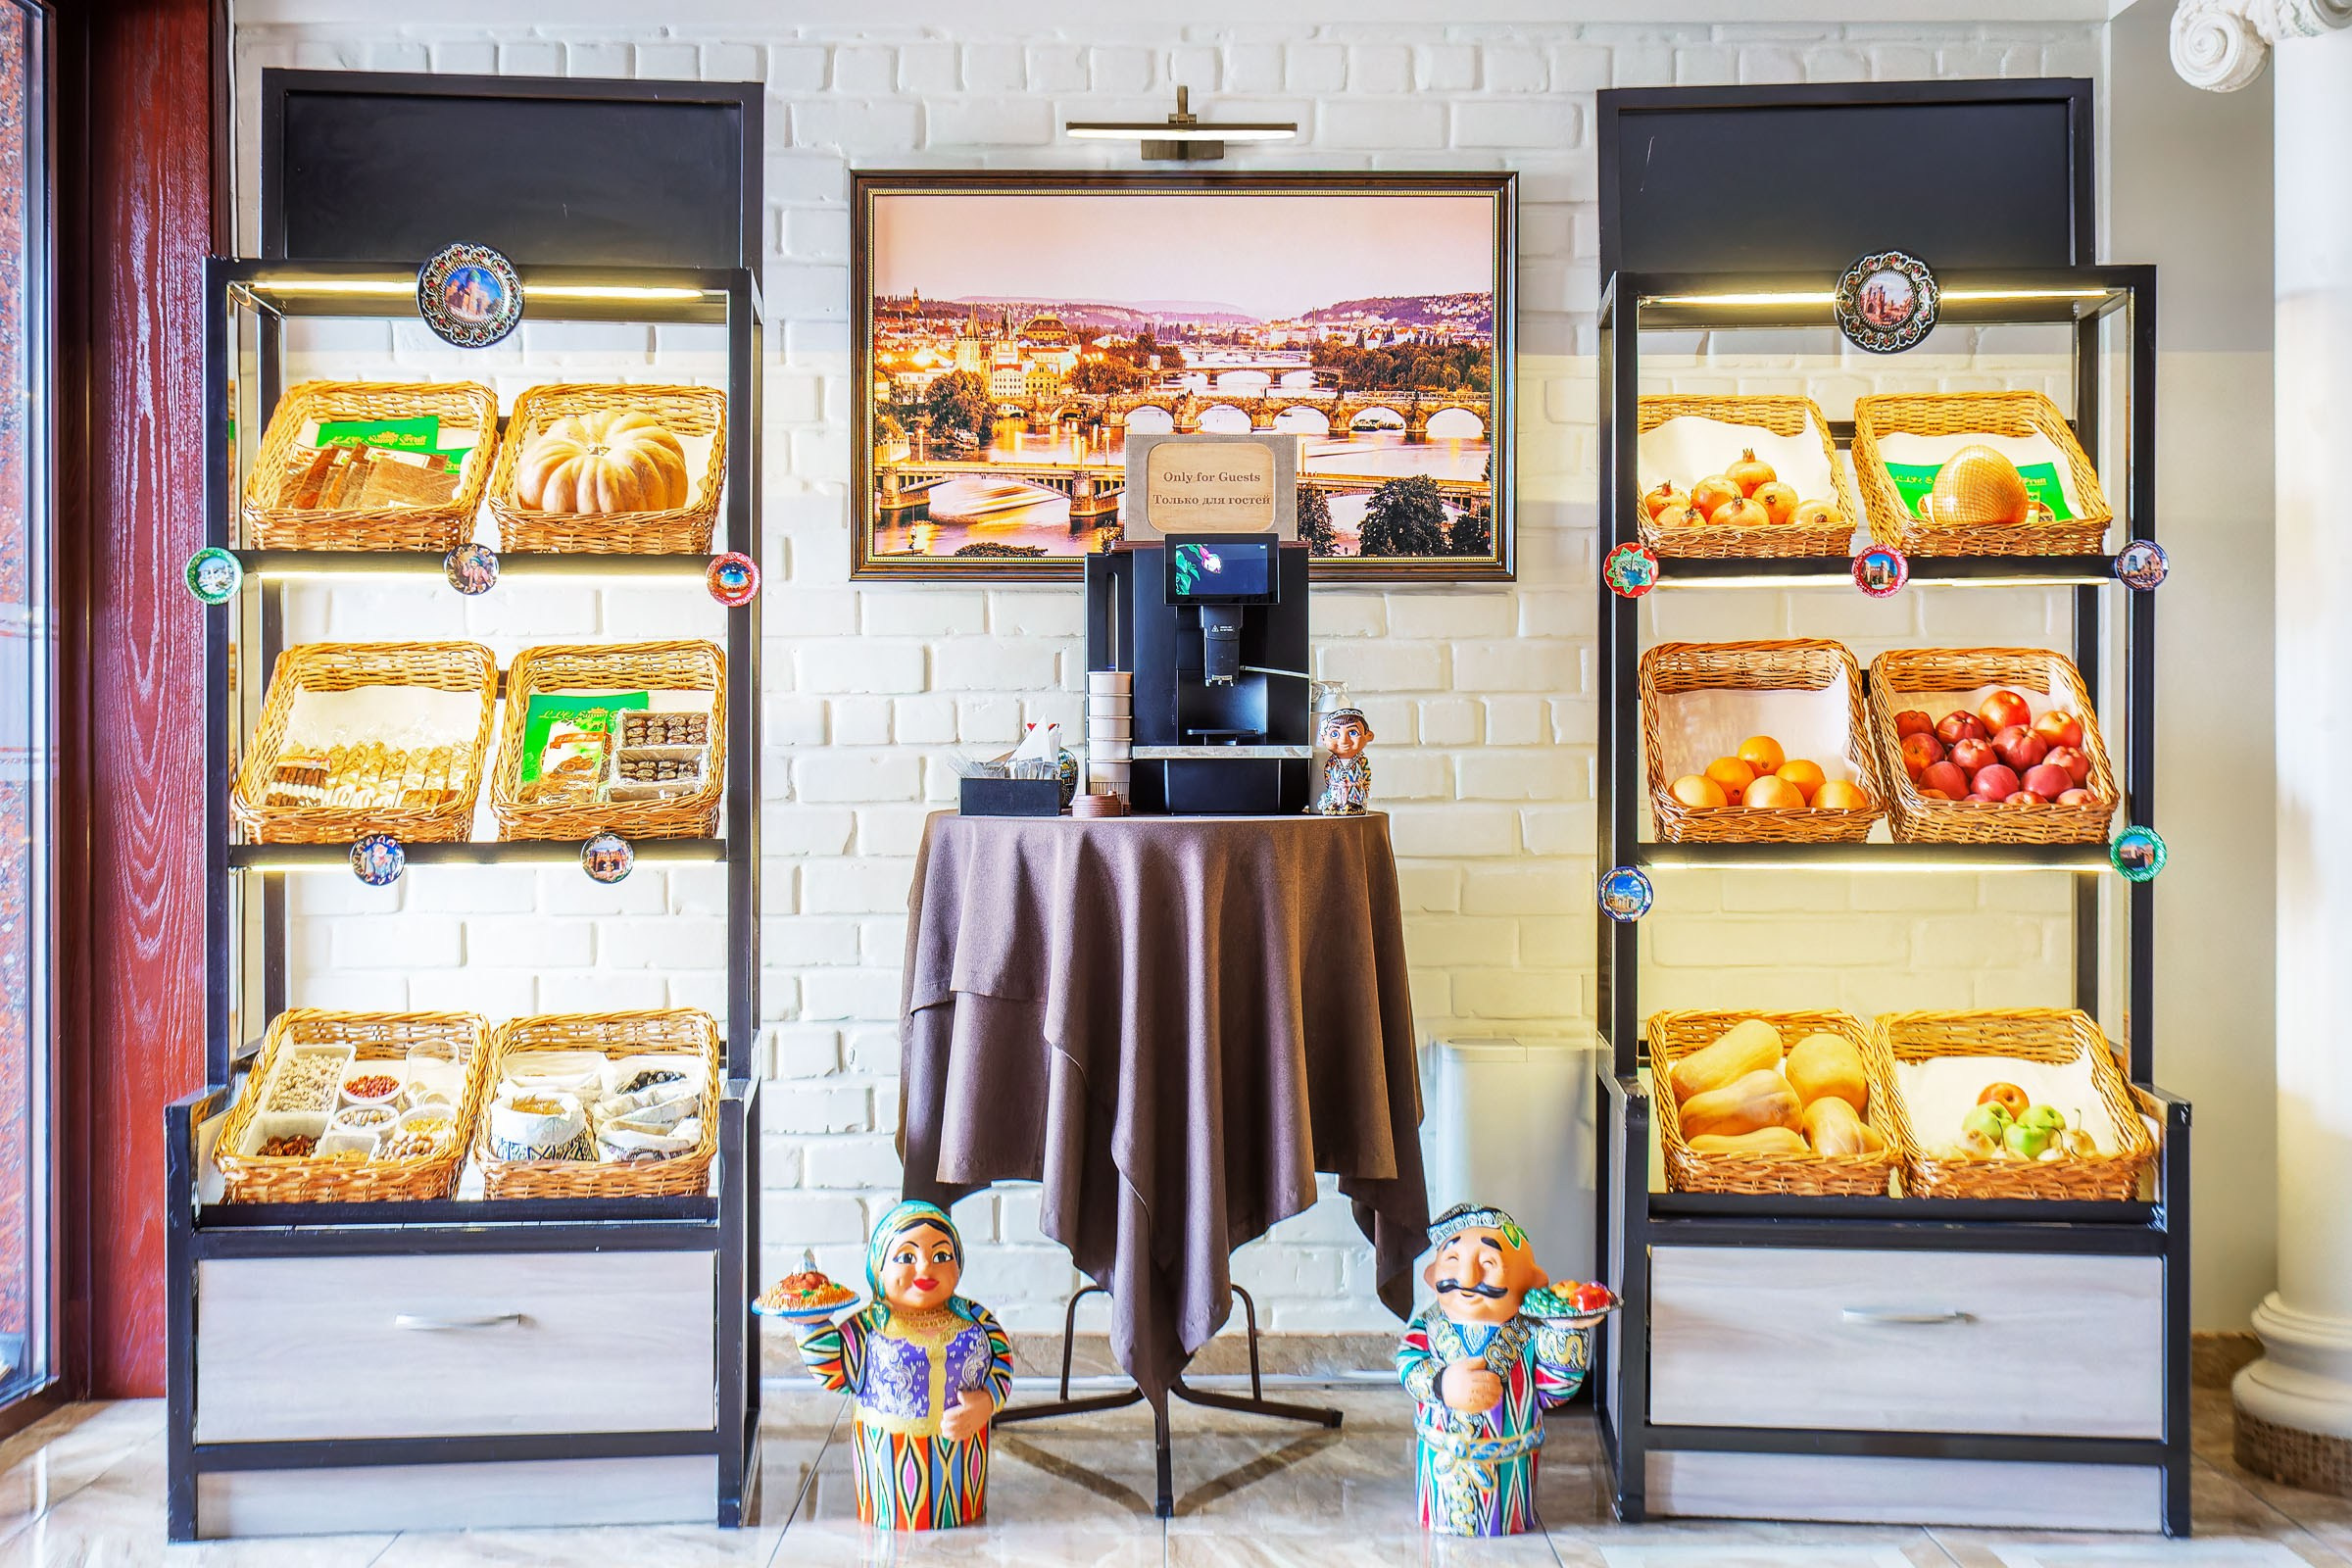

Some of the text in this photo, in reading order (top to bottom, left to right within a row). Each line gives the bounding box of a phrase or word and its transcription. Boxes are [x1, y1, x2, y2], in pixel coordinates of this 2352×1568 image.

[1163, 471, 1260, 483] Only for Guests
[1153, 494, 1270, 506] Только для гостей
